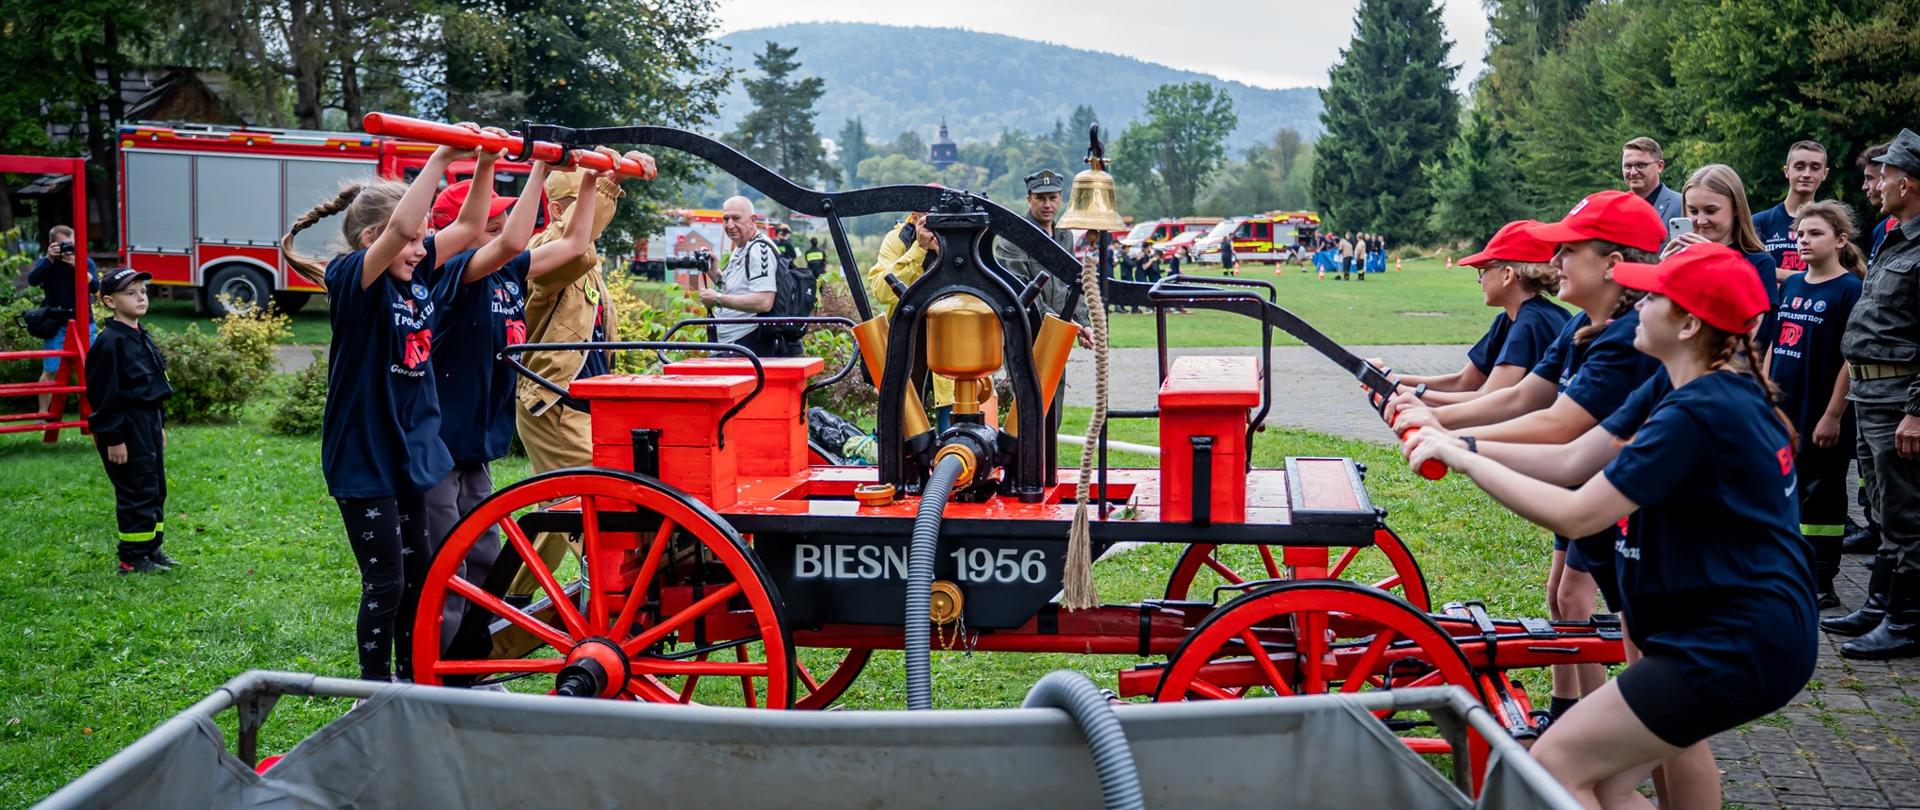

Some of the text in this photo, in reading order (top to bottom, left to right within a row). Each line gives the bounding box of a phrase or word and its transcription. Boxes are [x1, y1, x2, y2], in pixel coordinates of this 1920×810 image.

[1786, 349, 1802, 359] 2025
[795, 544, 1047, 583] BIESN 1956
